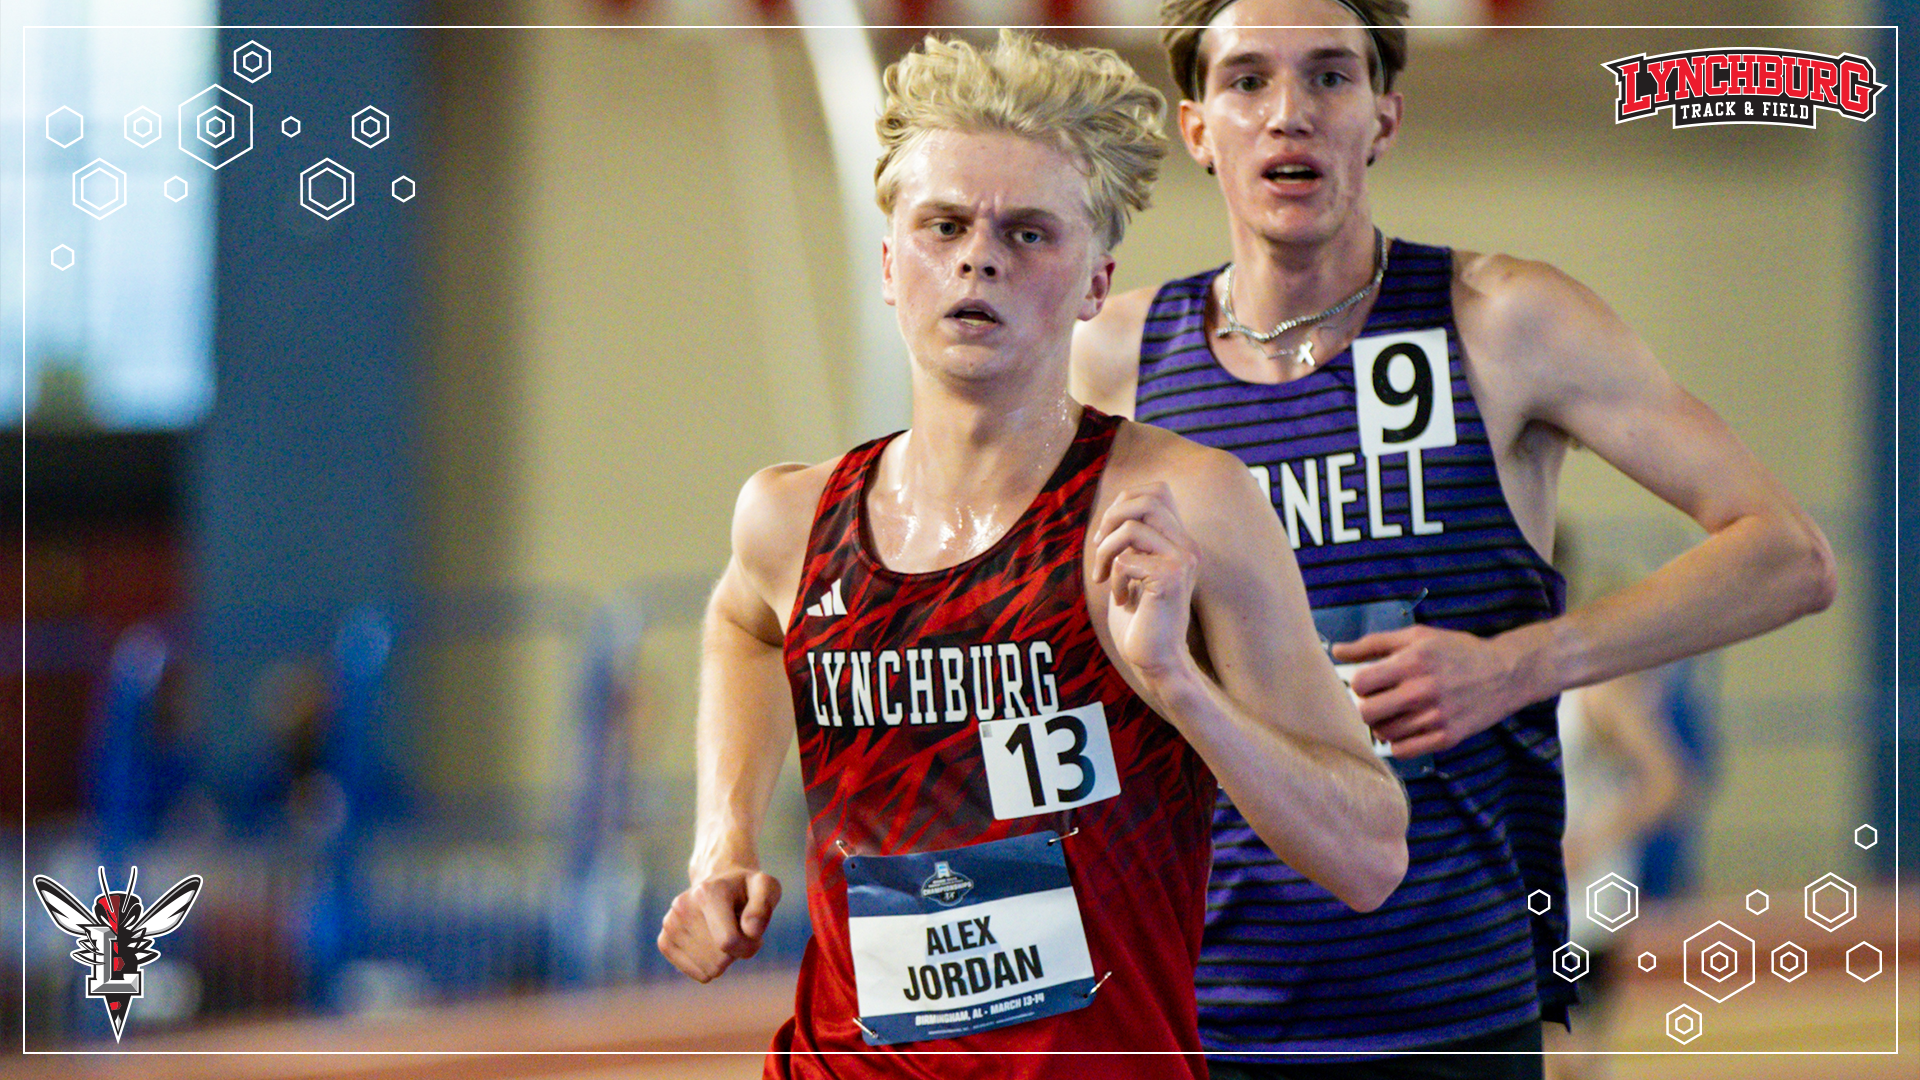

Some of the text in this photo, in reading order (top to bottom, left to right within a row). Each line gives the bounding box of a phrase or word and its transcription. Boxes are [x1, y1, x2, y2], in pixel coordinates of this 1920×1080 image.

[1372, 342, 1434, 444] 9
[806, 640, 1060, 727] LYNCHBURG
[1004, 715, 1096, 808] 13
[926, 915, 998, 956] ALEX
[902, 944, 1044, 1002] JORDAN
[972, 1008, 984, 1020] AL
[990, 999, 1022, 1015] MARCH
[1023, 992, 1045, 1008] 13-14
